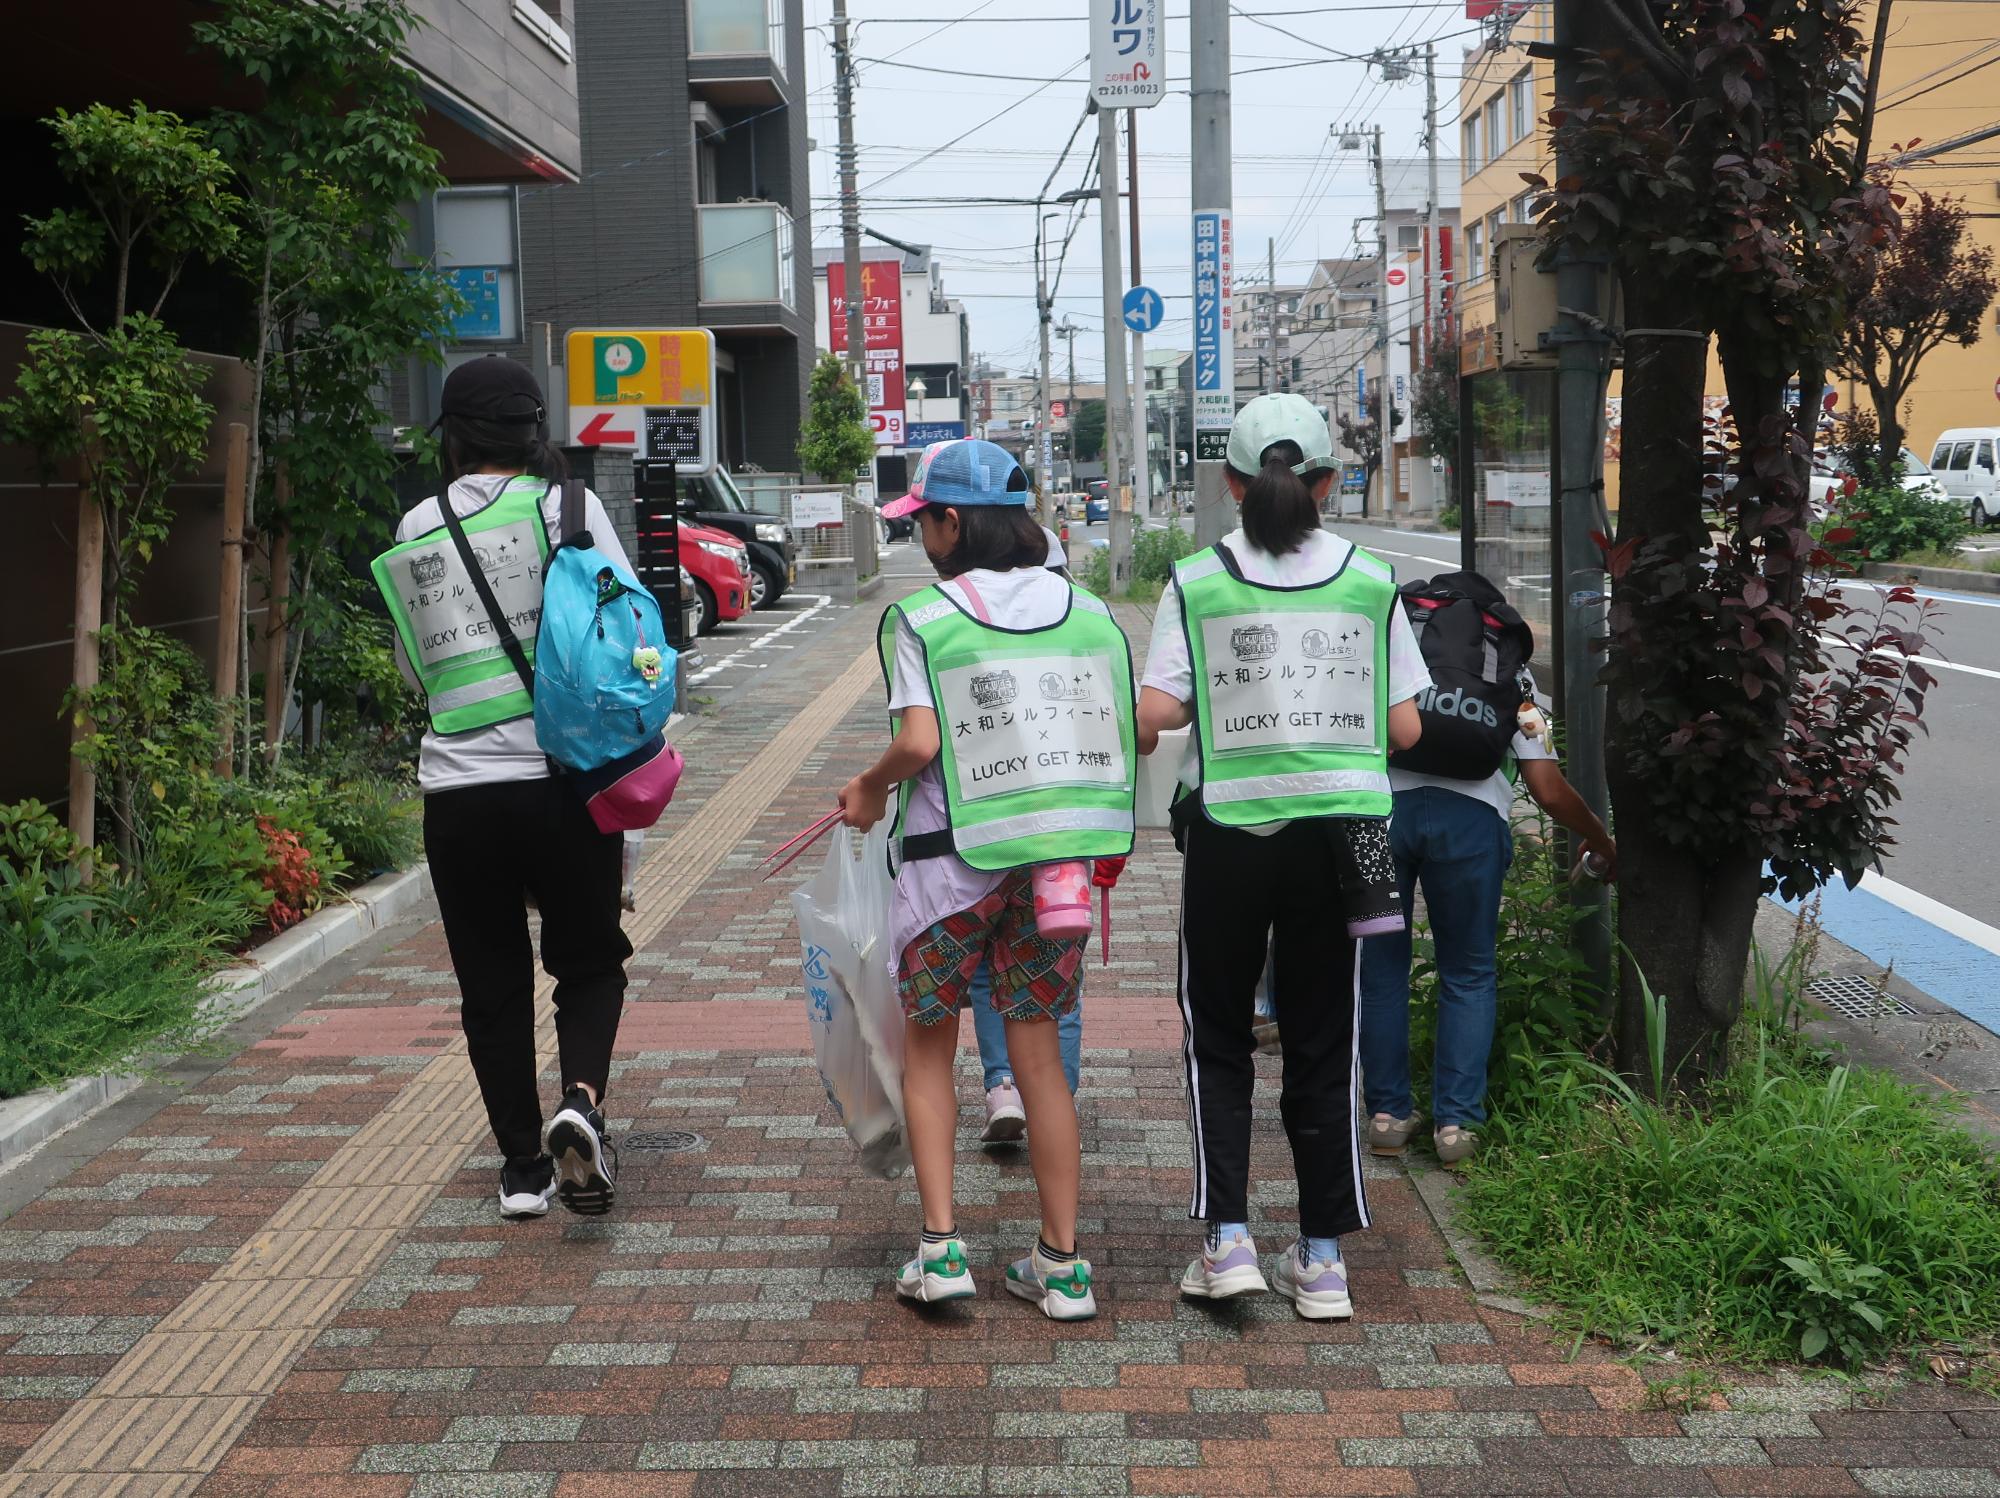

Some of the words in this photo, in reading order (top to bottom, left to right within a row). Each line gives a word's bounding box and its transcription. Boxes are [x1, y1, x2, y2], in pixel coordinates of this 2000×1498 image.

[1111, 84, 1158, 95] 261-0023
[1197, 219, 1216, 386] 田中内科クリニック
[422, 628, 459, 650] LUCKY
[465, 619, 494, 637] GET
[1213, 664, 1371, 687] 大和シルフィード
[955, 706, 1111, 738] 大和シルフィード
[1225, 713, 1280, 733] LUCKY
[1288, 712, 1323, 727] GET
[1329, 711, 1365, 730] 大作戦
[972, 755, 1028, 782] LUCKY
[1037, 751, 1070, 767] GET
[1077, 750, 1112, 767] 大作戦
